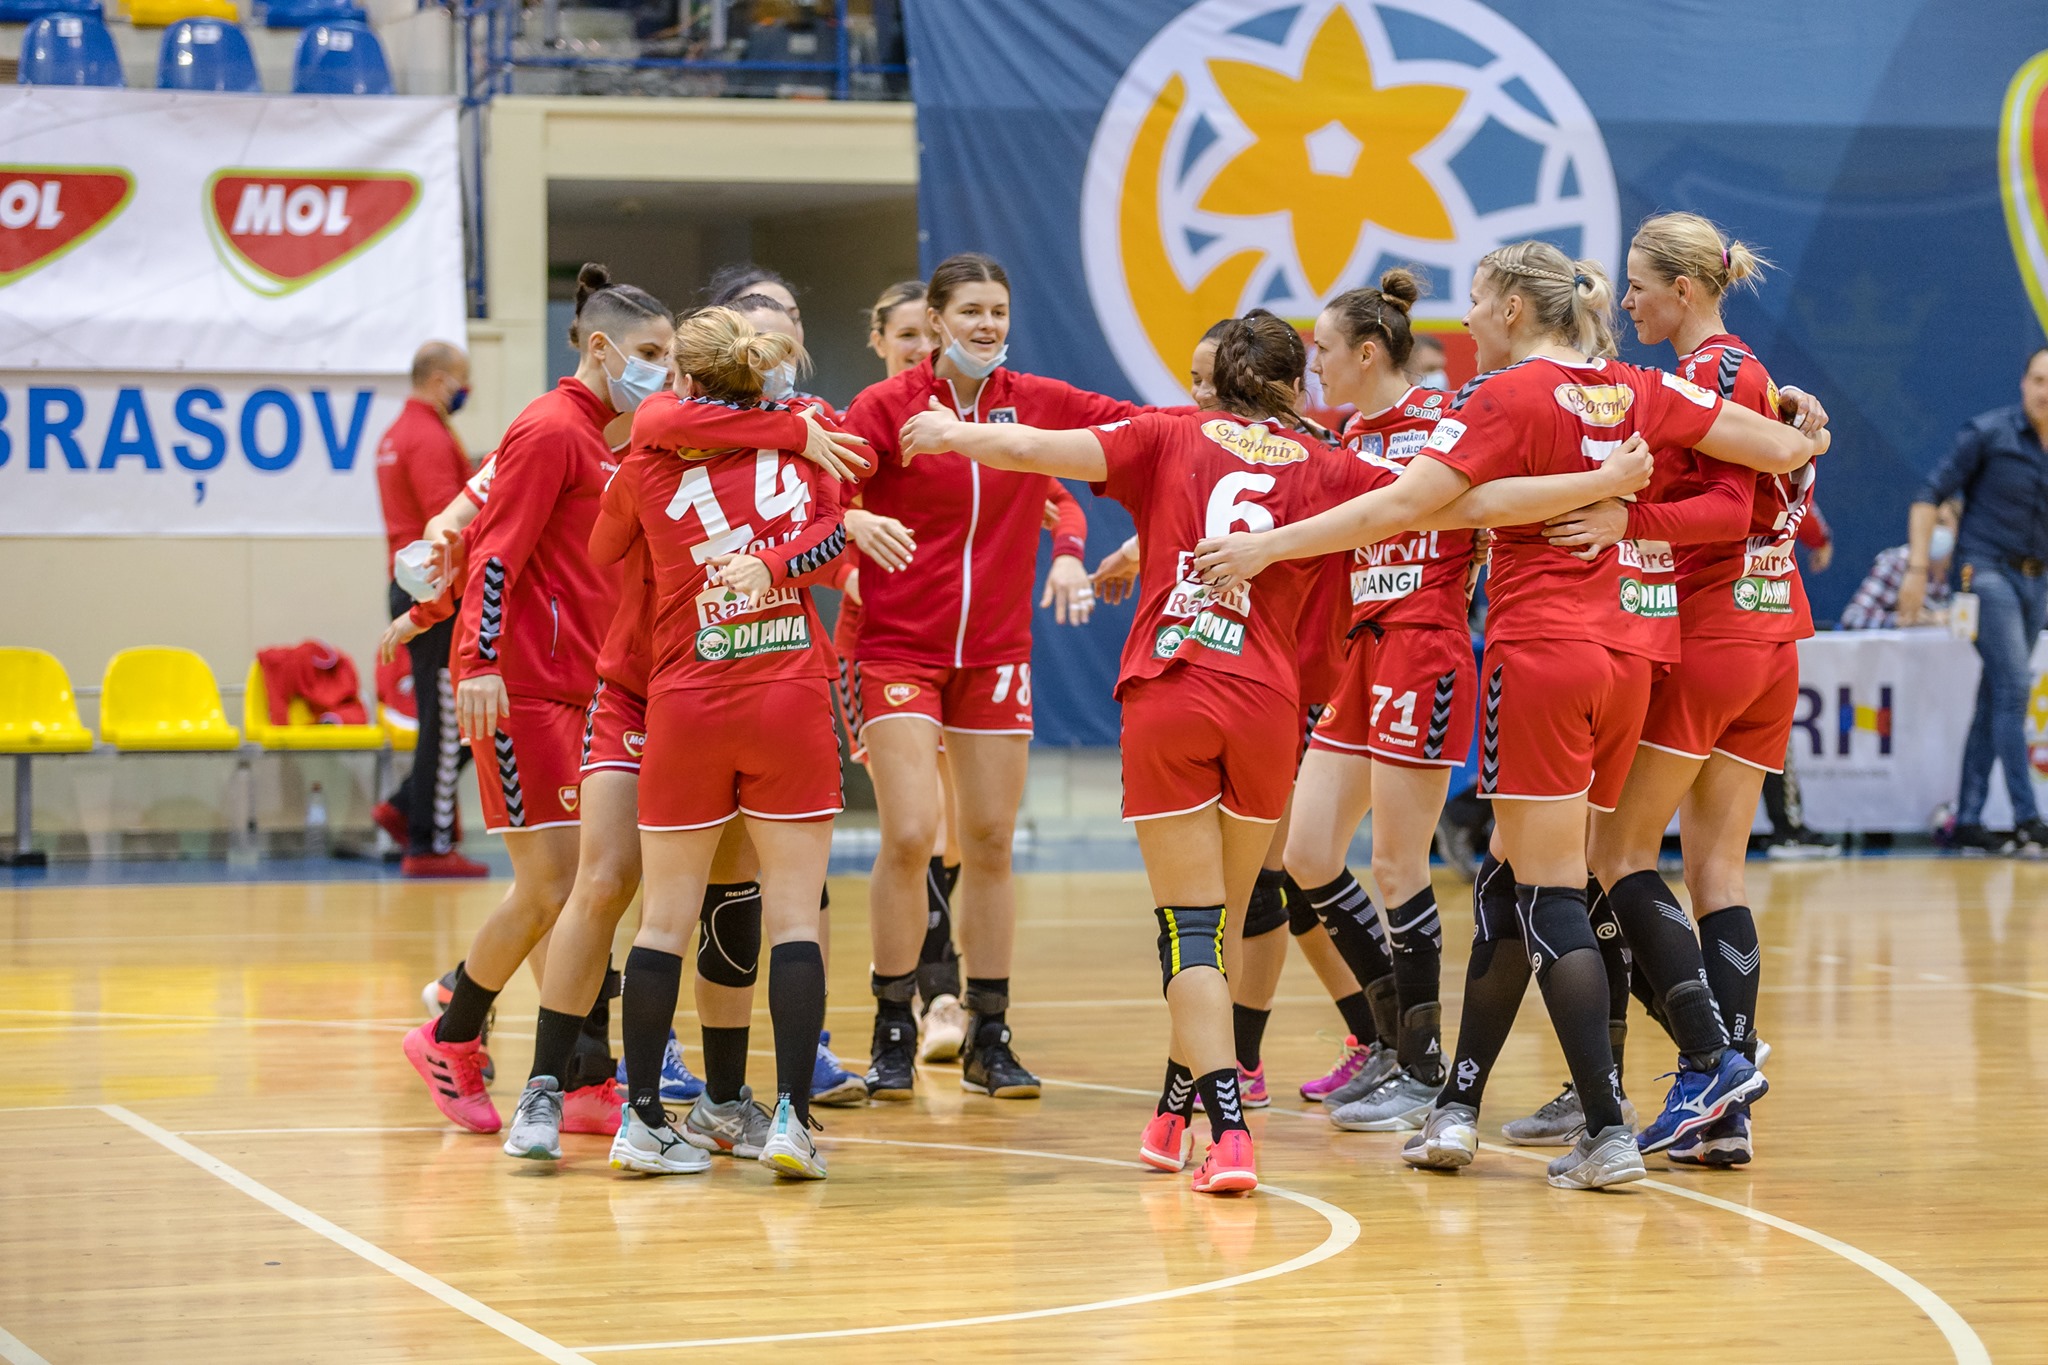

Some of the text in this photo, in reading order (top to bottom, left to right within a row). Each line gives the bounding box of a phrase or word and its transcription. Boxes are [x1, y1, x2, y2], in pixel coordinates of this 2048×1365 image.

[231, 184, 352, 236] MOL
[0, 386, 374, 506] RAȘOV
[665, 449, 811, 565] 14
[1205, 471, 1276, 538] 6
[734, 616, 806, 650] DIANA
[991, 662, 1031, 706] 78
[1370, 684, 1418, 736] 71
[1385, 736, 1417, 748] hummel
